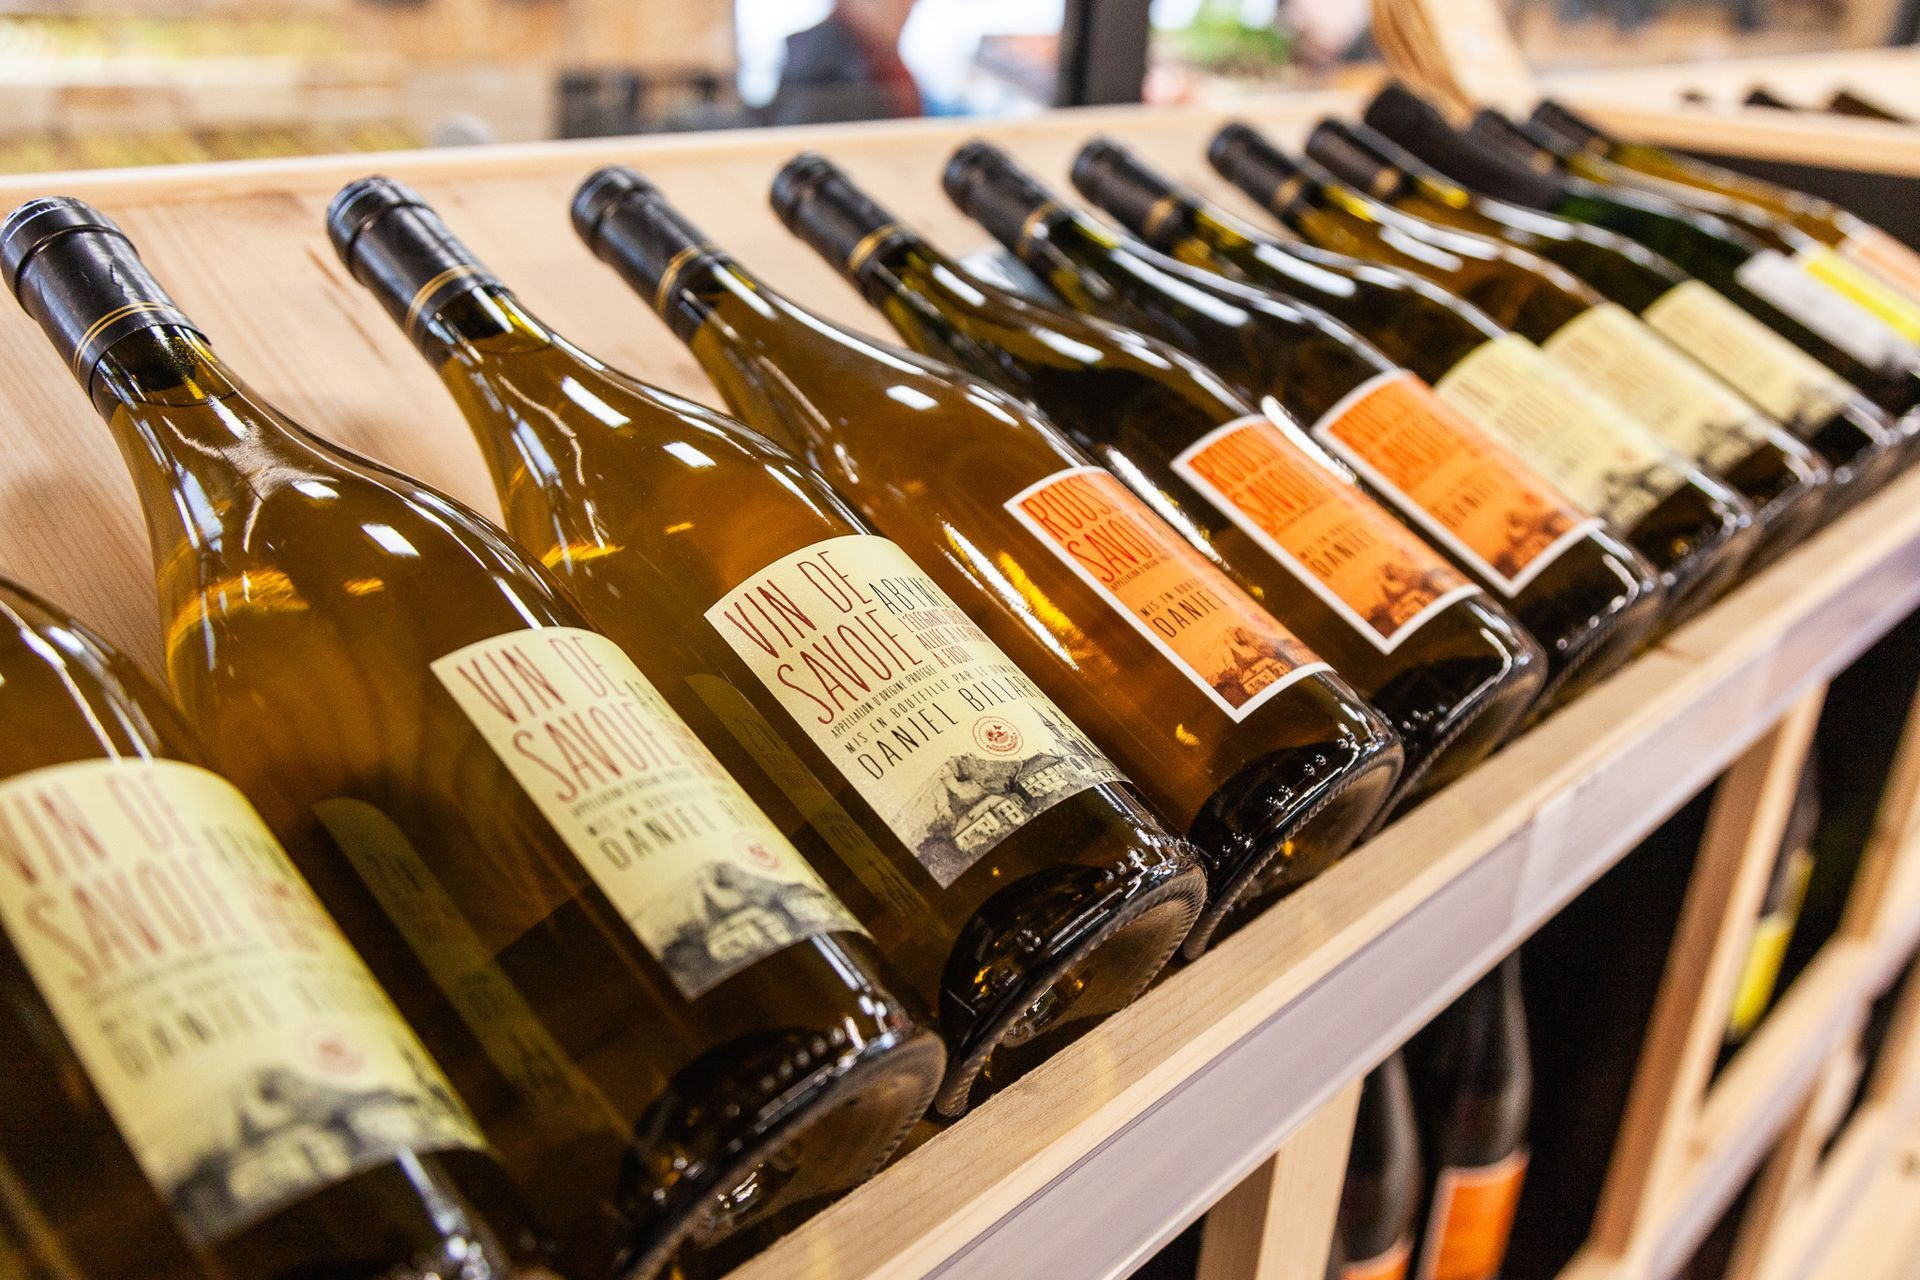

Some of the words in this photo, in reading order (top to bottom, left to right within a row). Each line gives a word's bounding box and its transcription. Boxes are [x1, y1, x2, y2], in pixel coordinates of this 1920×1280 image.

[724, 579, 817, 658] VIN
[797, 551, 872, 613] DE
[1140, 601, 1160, 616] MIS
[1152, 587, 1228, 638] DANIEL
[457, 645, 565, 723] VIN
[548, 636, 627, 697] DE
[777, 609, 923, 724] SAVOIE
[941, 645, 974, 665] FUSIL
[831, 702, 874, 738] APPELLATION
[872, 680, 907, 706] D'ORIGINE
[844, 732, 868, 754] MIS
[869, 717, 888, 733] EN
[890, 679, 950, 718] BOUTEILLE
[952, 670, 974, 684] PAR
[857, 703, 959, 779] DANIEL
[513, 702, 680, 803] SAVOIE
[104, 768, 199, 851] DE
[599, 803, 719, 872] DANIEL
[24, 855, 246, 991] SAVOIE
